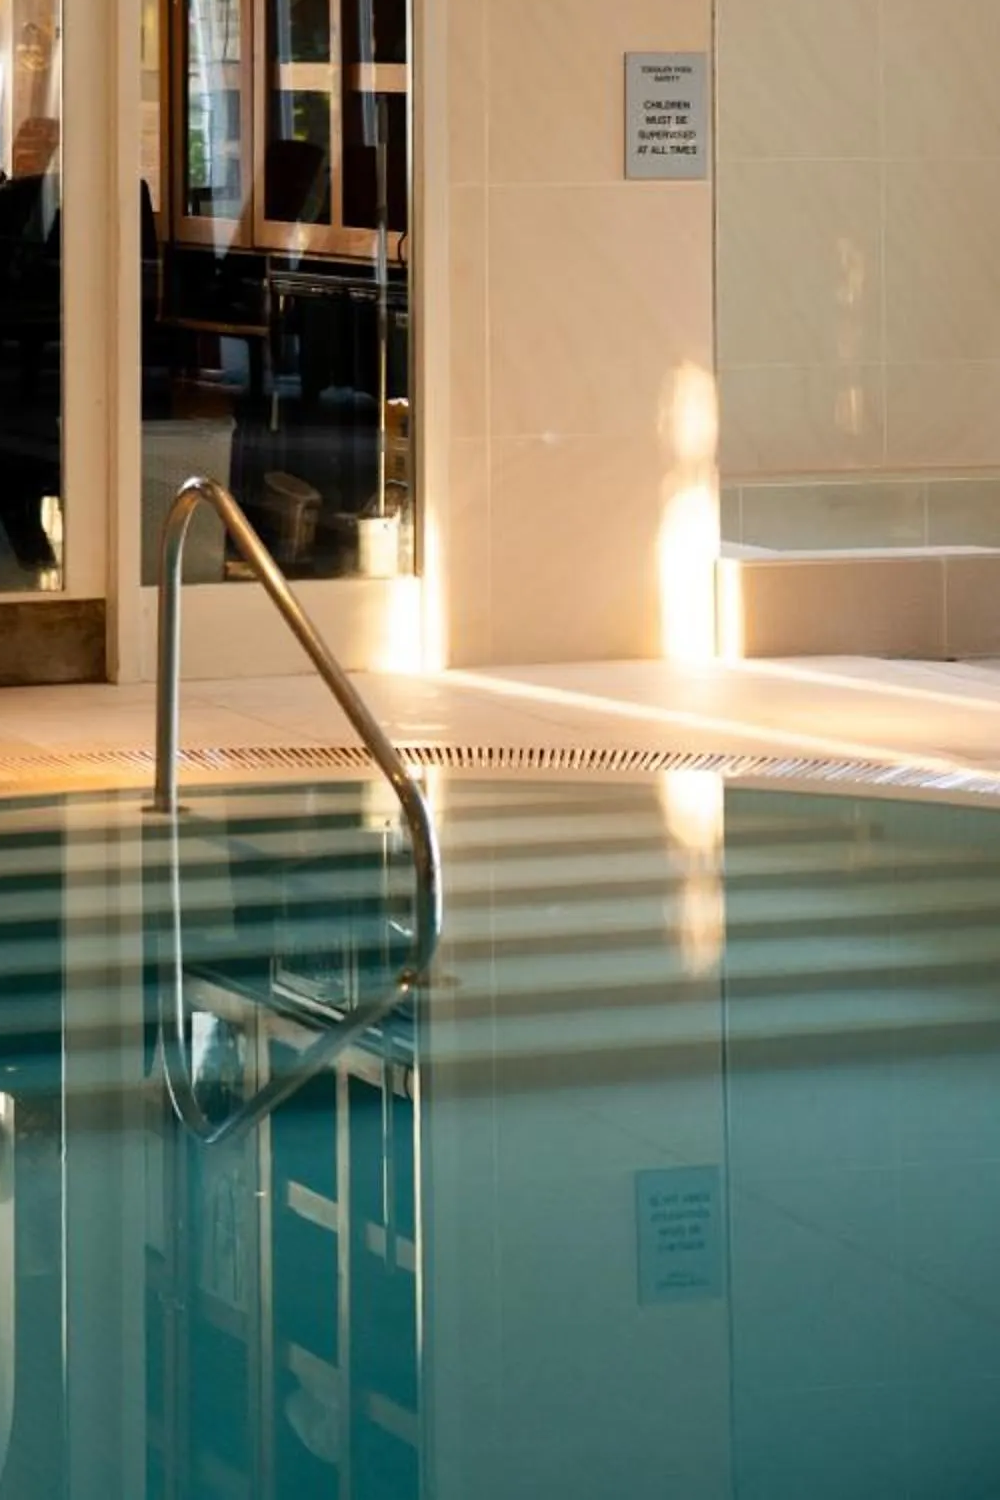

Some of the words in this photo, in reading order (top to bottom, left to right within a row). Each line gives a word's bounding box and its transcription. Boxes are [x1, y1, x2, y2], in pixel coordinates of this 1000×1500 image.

[643, 100, 690, 109] CHILDREN
[645, 115, 672, 124] MUST
[676, 115, 688, 124] BE
[638, 130, 697, 139] SUPERVISED
[637, 145, 648, 154] AT
[650, 145, 668, 154] ALL
[669, 145, 697, 154] TIMES
